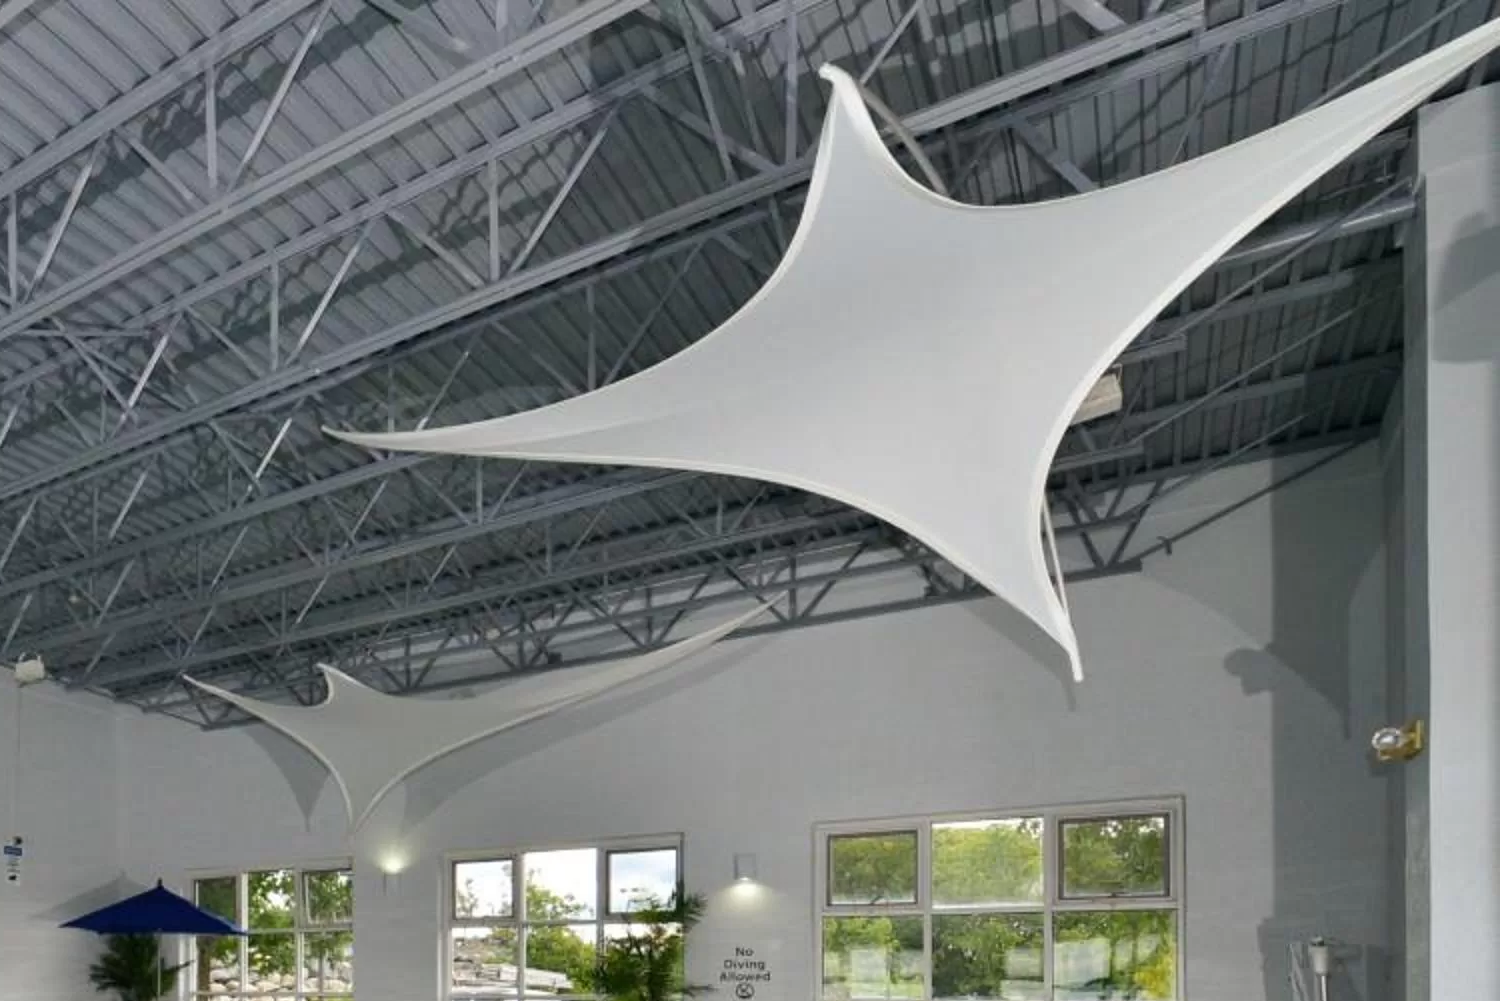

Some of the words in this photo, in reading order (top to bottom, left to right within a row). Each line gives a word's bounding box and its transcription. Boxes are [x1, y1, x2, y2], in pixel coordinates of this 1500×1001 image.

[735, 947, 754, 956] No
[724, 960, 764, 970] Diving
[720, 971, 770, 981] Allowed
